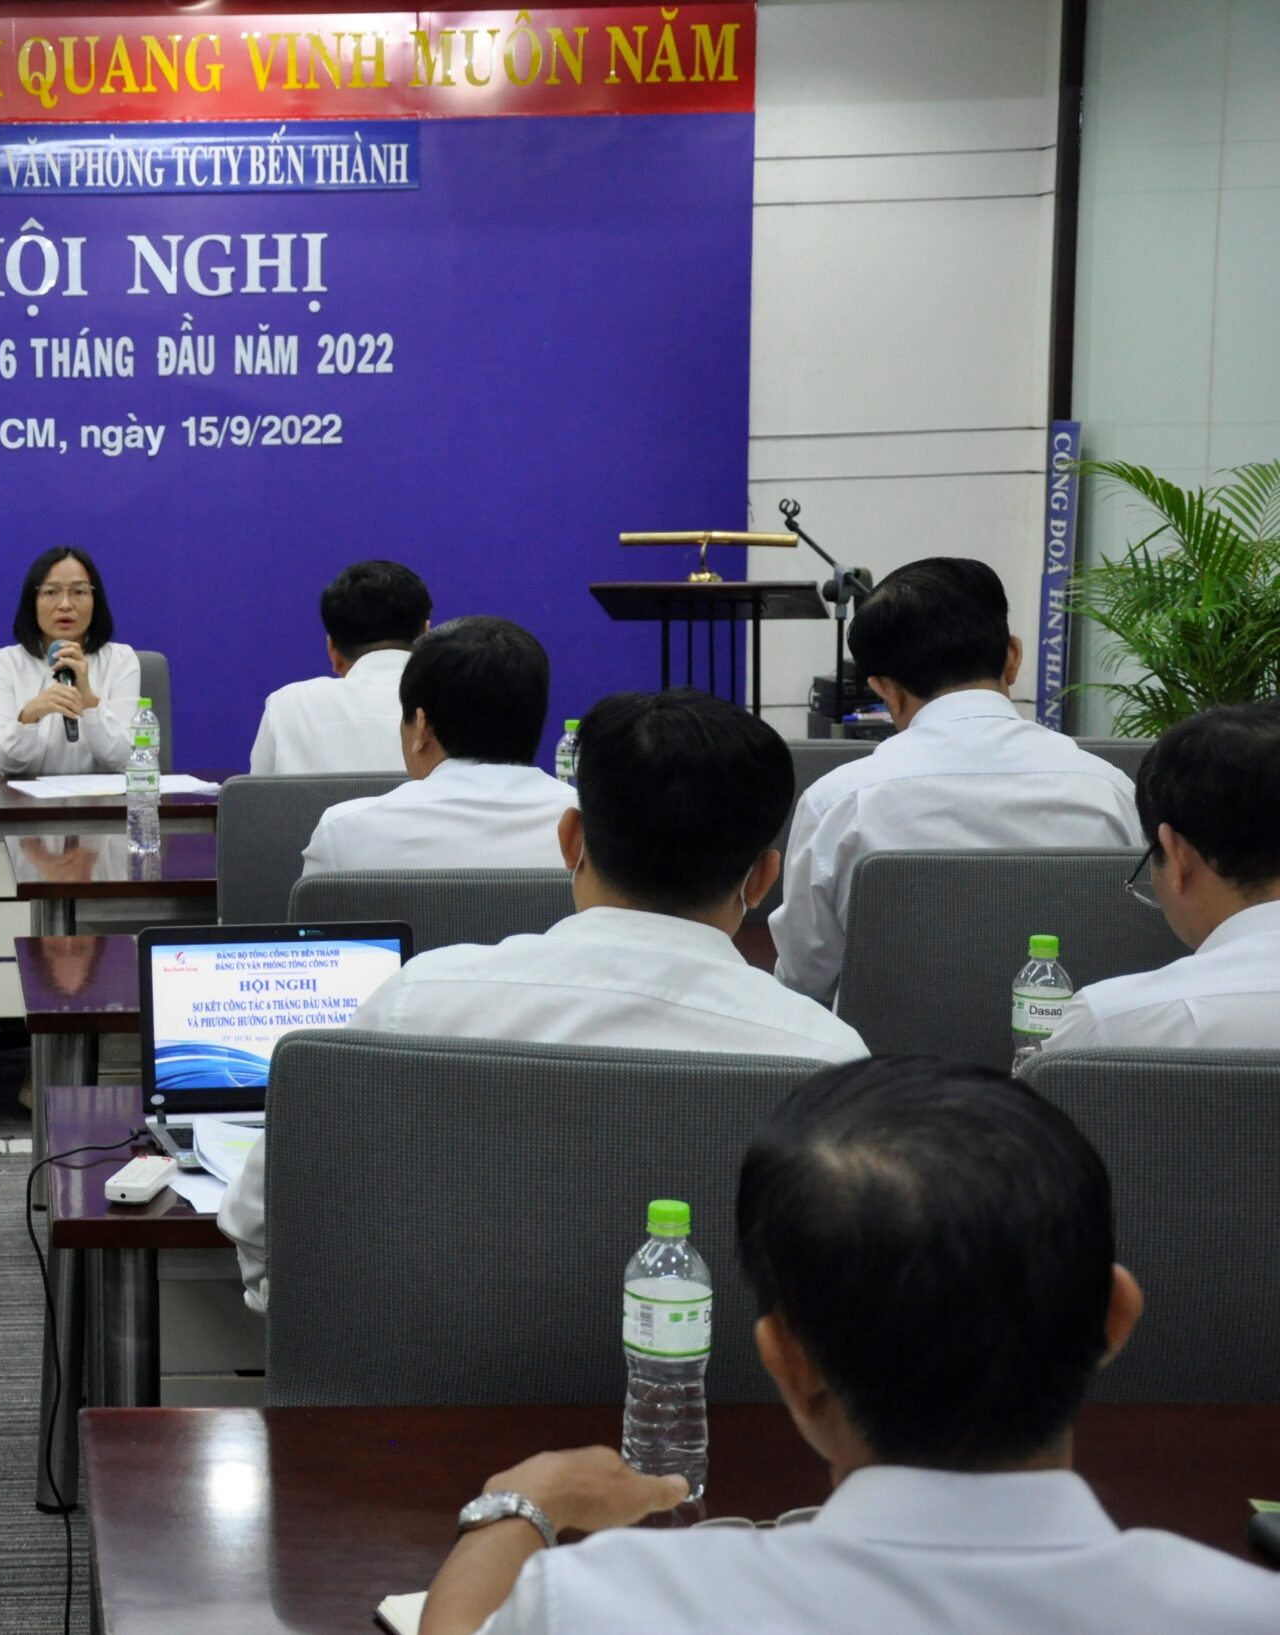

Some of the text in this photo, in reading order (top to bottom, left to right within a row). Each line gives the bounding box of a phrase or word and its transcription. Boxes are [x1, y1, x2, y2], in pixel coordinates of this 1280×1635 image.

[18, 34, 224, 109] QUANG
[241, 31, 391, 91] VINH
[409, 8, 589, 87] MUÔN
[605, 6, 740, 84] NĂM
[4, 136, 63, 187] VĂN
[68, 134, 165, 187] PHÒNG
[171, 145, 245, 187] TCTY
[248, 125, 306, 185] BẾN
[311, 131, 410, 184] THÀNH
[127, 233, 329, 312] NGHỊ
[30, 327, 135, 378] THÁNG
[157, 312, 216, 376] ĐẦU
[234, 323, 299, 376] NĂM
[317, 333, 395, 375] 2022
[80, 413, 166, 456] ngày
[181, 414, 344, 447] 15/9/2022
[290, 949, 300, 958] TY
[329, 959, 339, 968] TY
[239, 978, 318, 994] HỘI NGHỊ
[223, 998, 247, 1012] CÔNG
[266, 1000, 271, 1011] 6
[272, 996, 301, 1010] THÁNG
[342, 997, 358, 1008] 2022
[269, 1015, 274, 1026] 6
[275, 1011, 304, 1025] THÁNG
